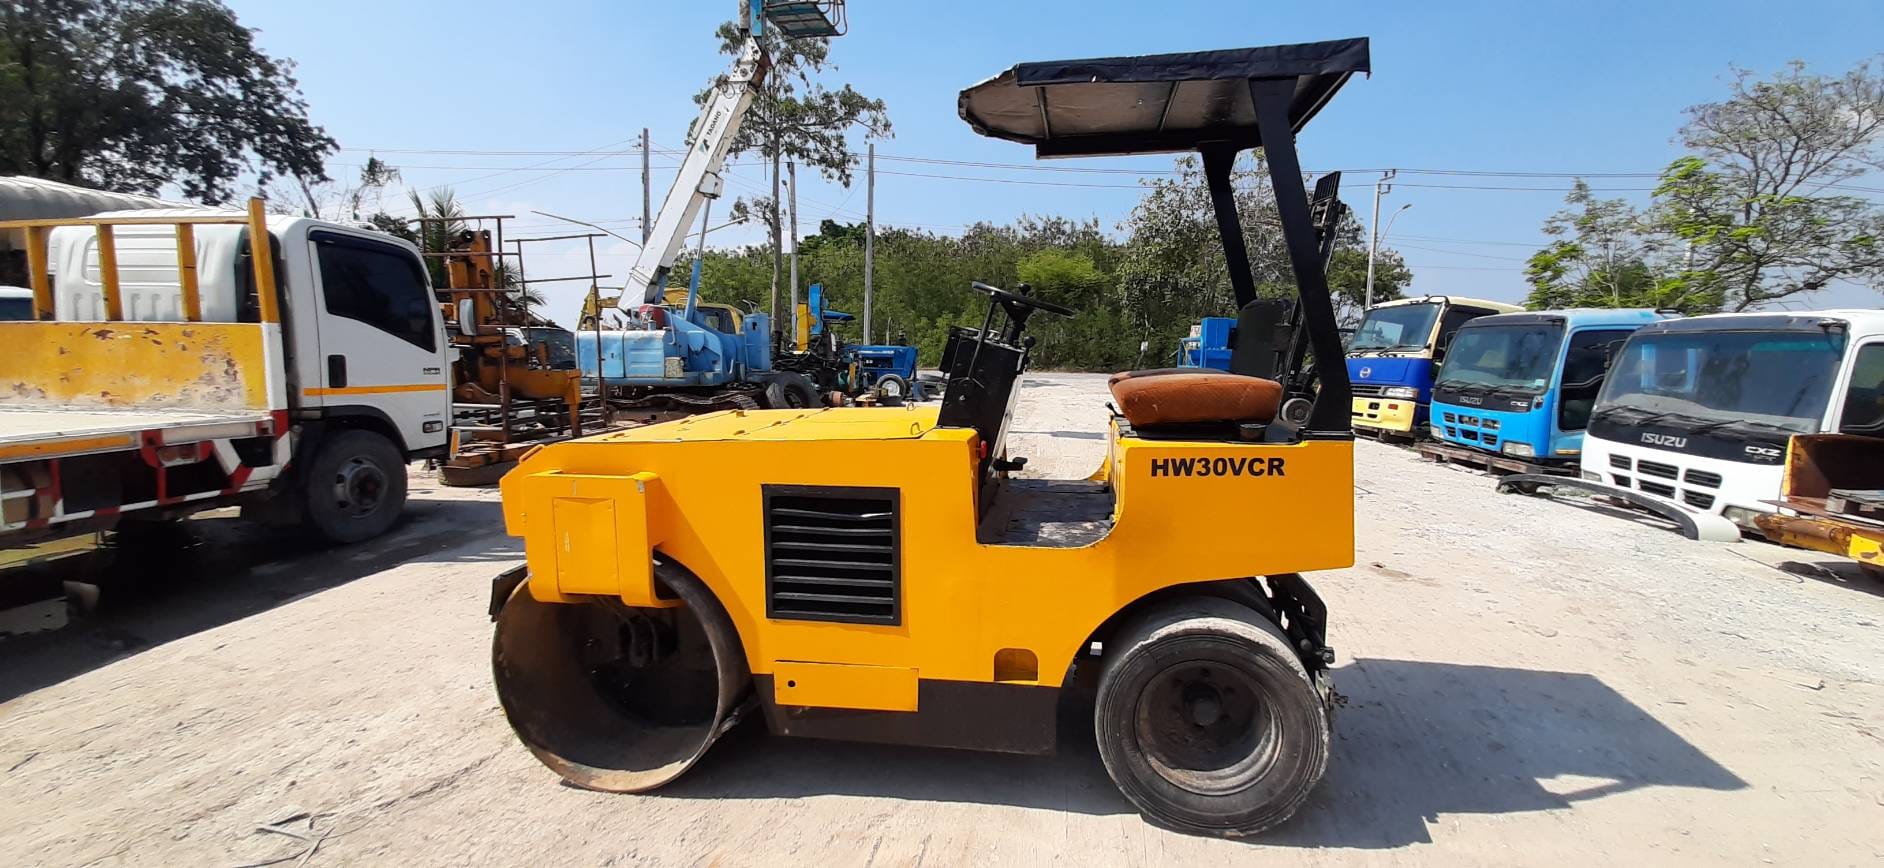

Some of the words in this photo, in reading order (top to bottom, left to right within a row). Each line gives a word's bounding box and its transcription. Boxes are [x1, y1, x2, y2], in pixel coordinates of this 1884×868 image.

[706, 111, 722, 136] TADANO
[1460, 396, 1483, 405] ISUZU
[1640, 432, 1687, 448] ISUZU
[1744, 445, 1781, 457] CXZ
[1151, 457, 1285, 477] HW30VCR
